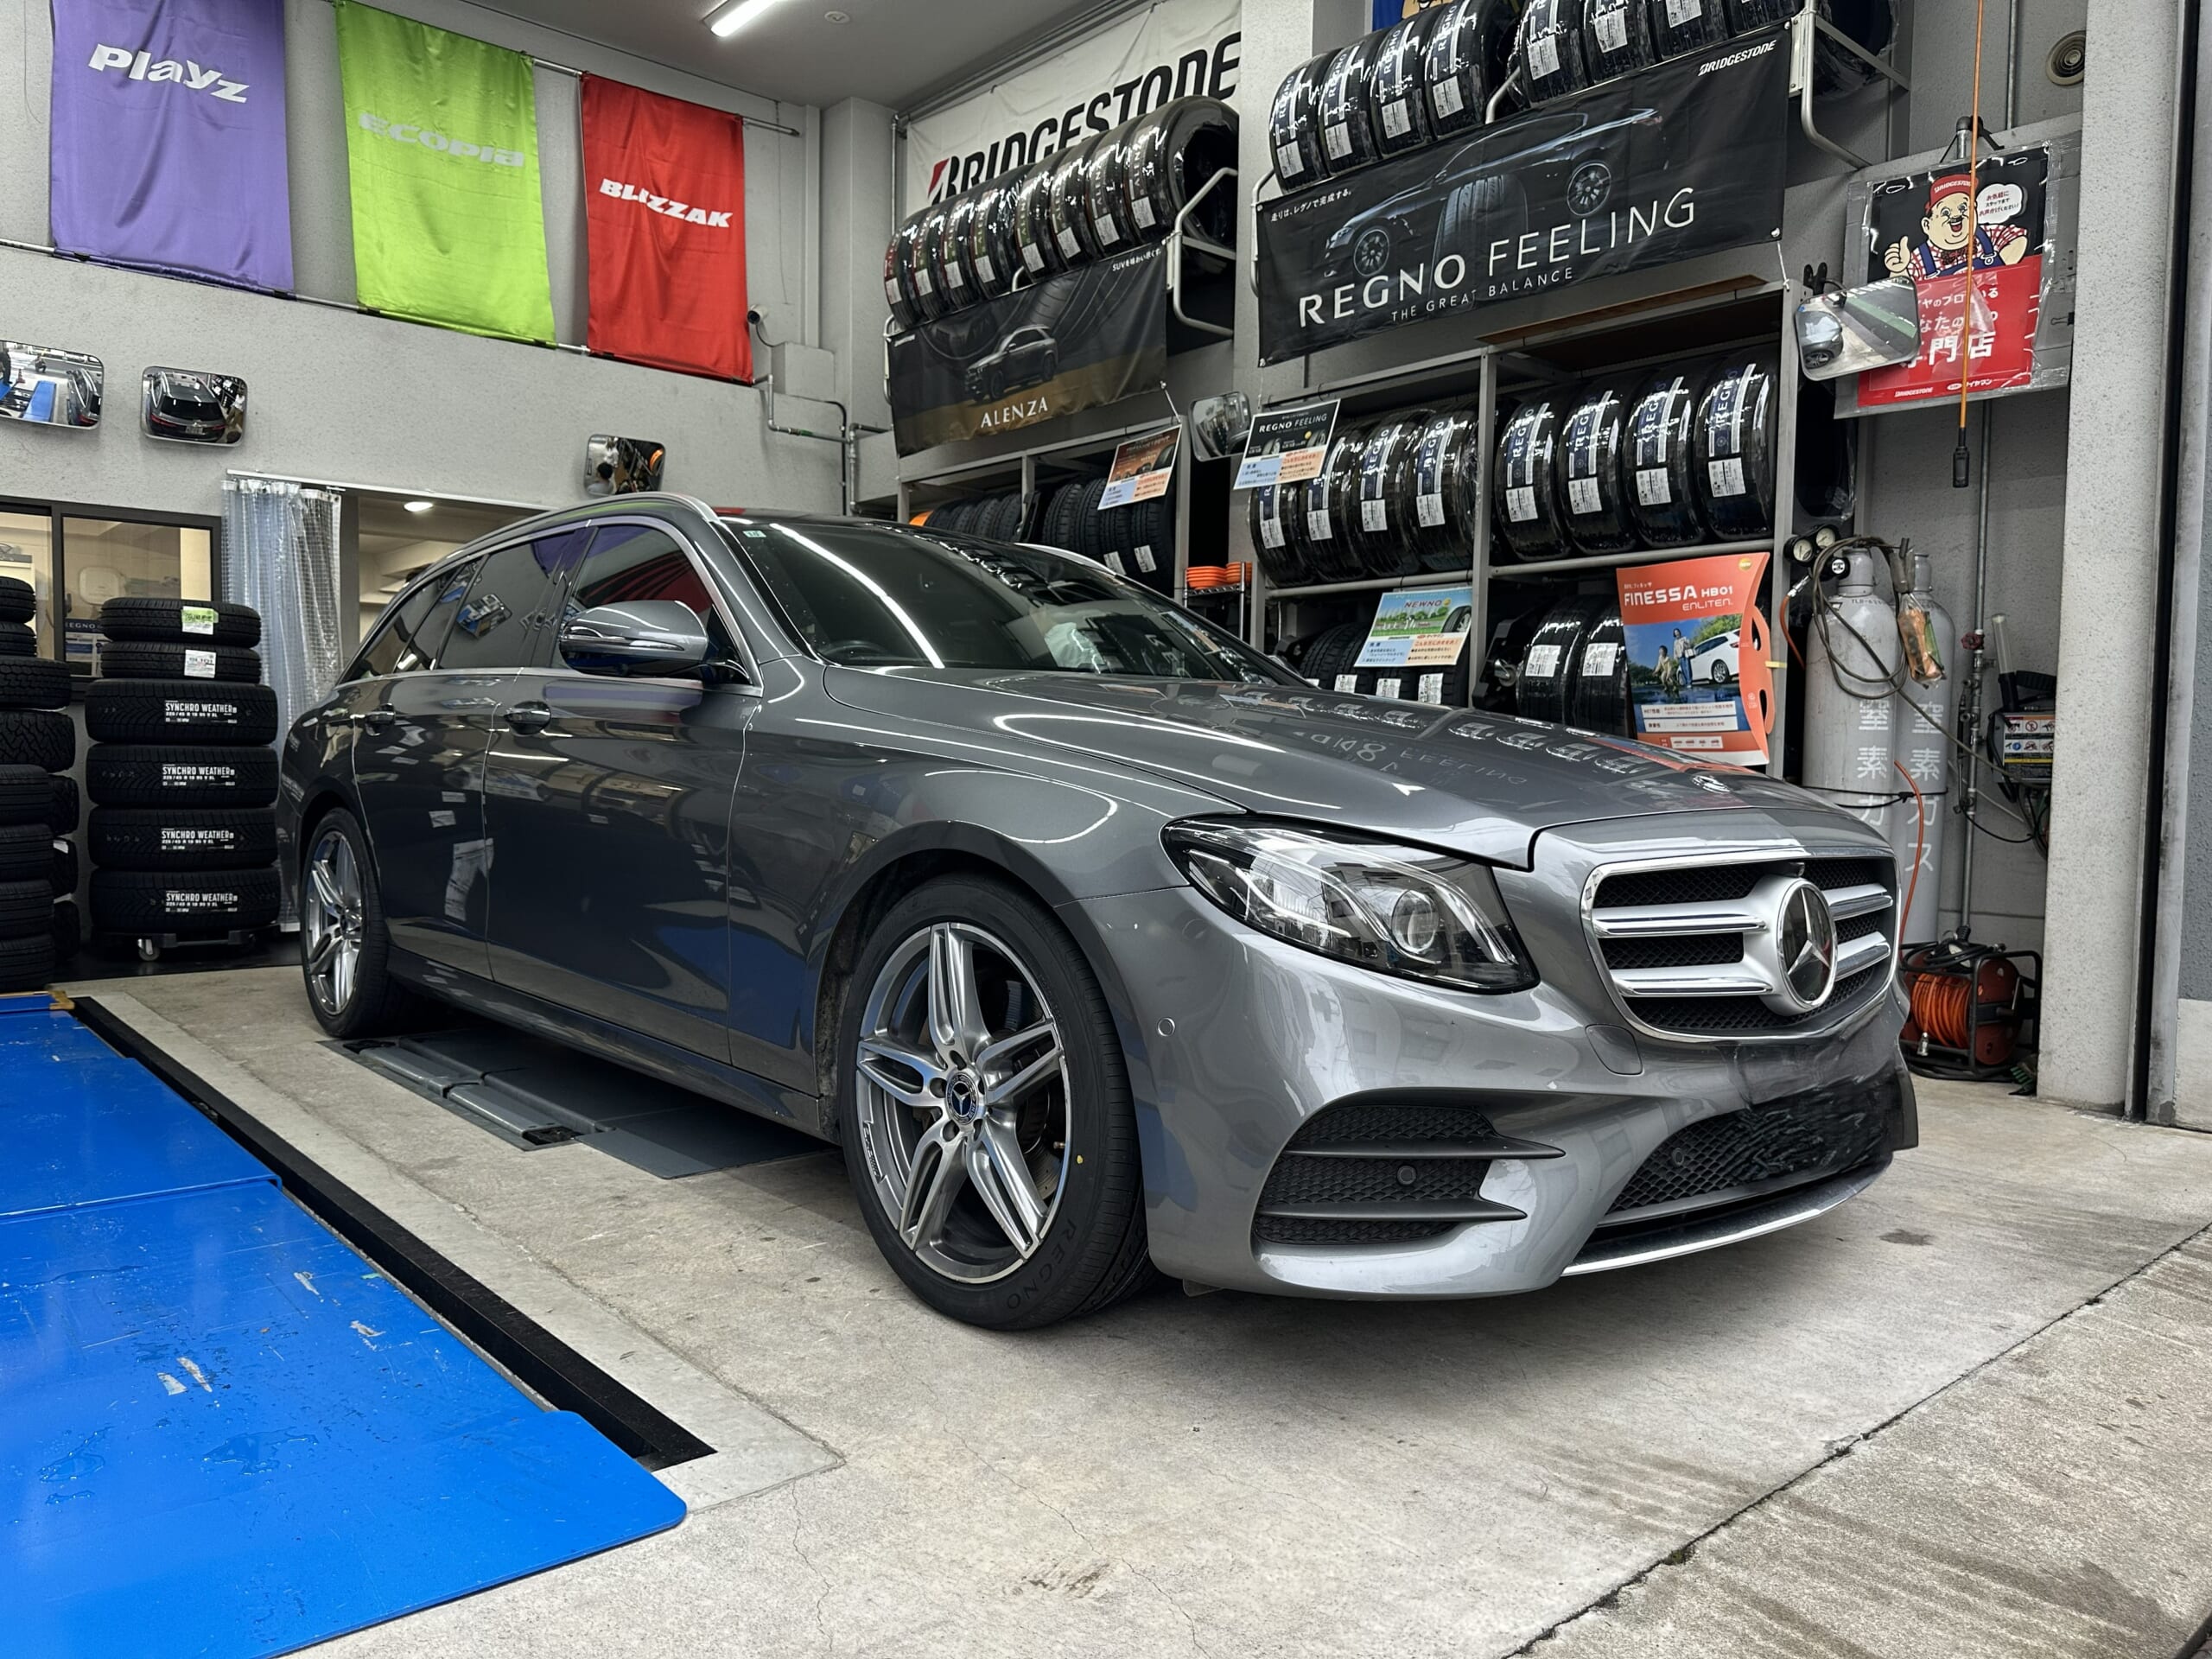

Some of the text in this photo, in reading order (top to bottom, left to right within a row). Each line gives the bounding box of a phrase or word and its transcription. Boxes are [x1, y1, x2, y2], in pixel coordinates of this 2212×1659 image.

[88, 43, 250, 104] Playz
[1698, 40, 1777, 77] BRIDGESTONE
[928, 31, 1242, 205] BRIDGESTONE
[600, 178, 734, 229] BLIZZAK
[1271, 188, 1351, 222] 走りは、レグノで完成する。
[1299, 187, 1695, 327] REGNO FEELING
[1391, 267, 1573, 322] THE GREAT BALANCE
[981, 397, 1049, 429] ALENZA
[1259, 421, 1293, 433] REGNO
[1294, 413, 1327, 427] FEELING
[1624, 585, 1733, 607] FINESSA HB01
[165, 702, 232, 712] SYNCHRO WEATHER
[162, 766, 231, 775] SYNCHRO WEATHER
[162, 830, 230, 839] SYNCHRO WEATHER
[166, 893, 233, 901] SYNCHRO WEATHER
